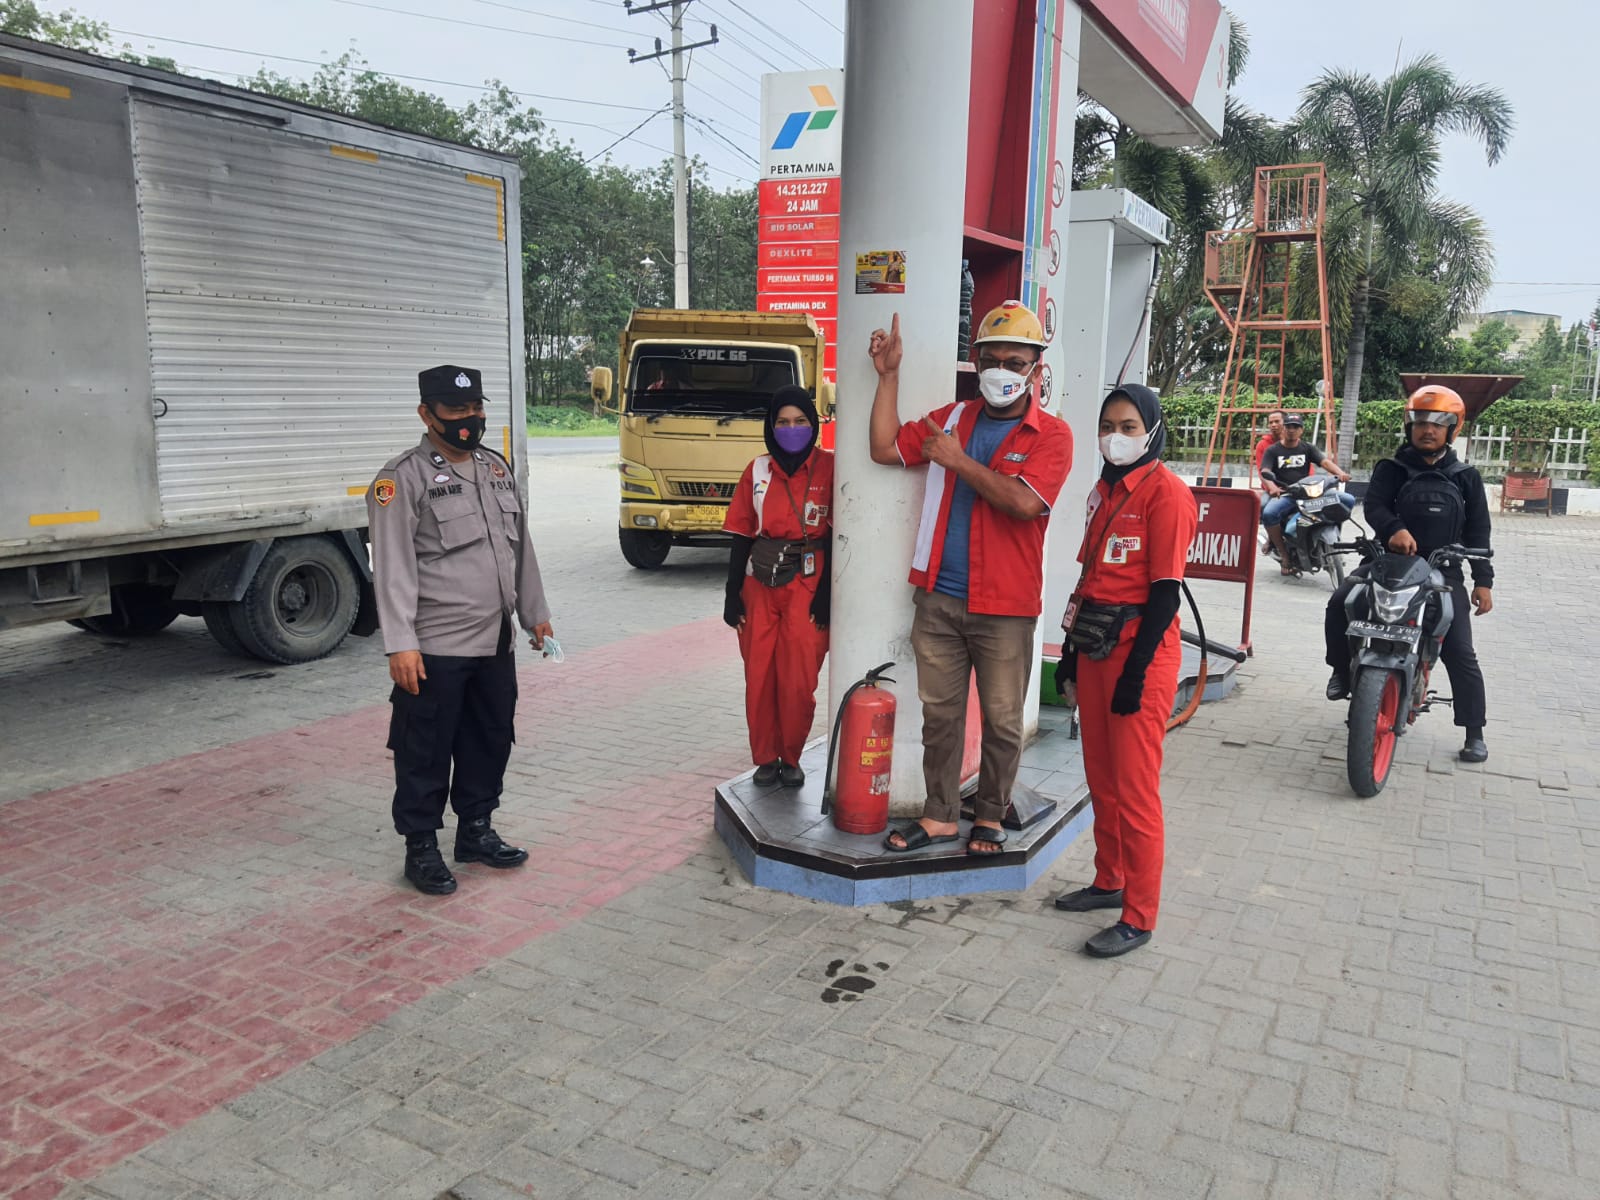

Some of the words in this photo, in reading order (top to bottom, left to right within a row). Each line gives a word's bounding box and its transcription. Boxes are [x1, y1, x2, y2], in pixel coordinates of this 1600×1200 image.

[770, 162, 835, 175] PERTAMINA
[776, 182, 828, 197] 14.212.227
[786, 200, 798, 213] 24
[799, 199, 819, 212] JAM
[770, 223, 785, 232] BIO
[787, 222, 814, 231] SOLAR
[769, 248, 813, 257] DEXLITE
[767, 275, 801, 283] PERTAMAX
[802, 273, 825, 282] TURBO
[769, 302, 810, 310] PERTAMINA
[811, 301, 827, 309] DEX
[1197, 502, 1211, 522] F
